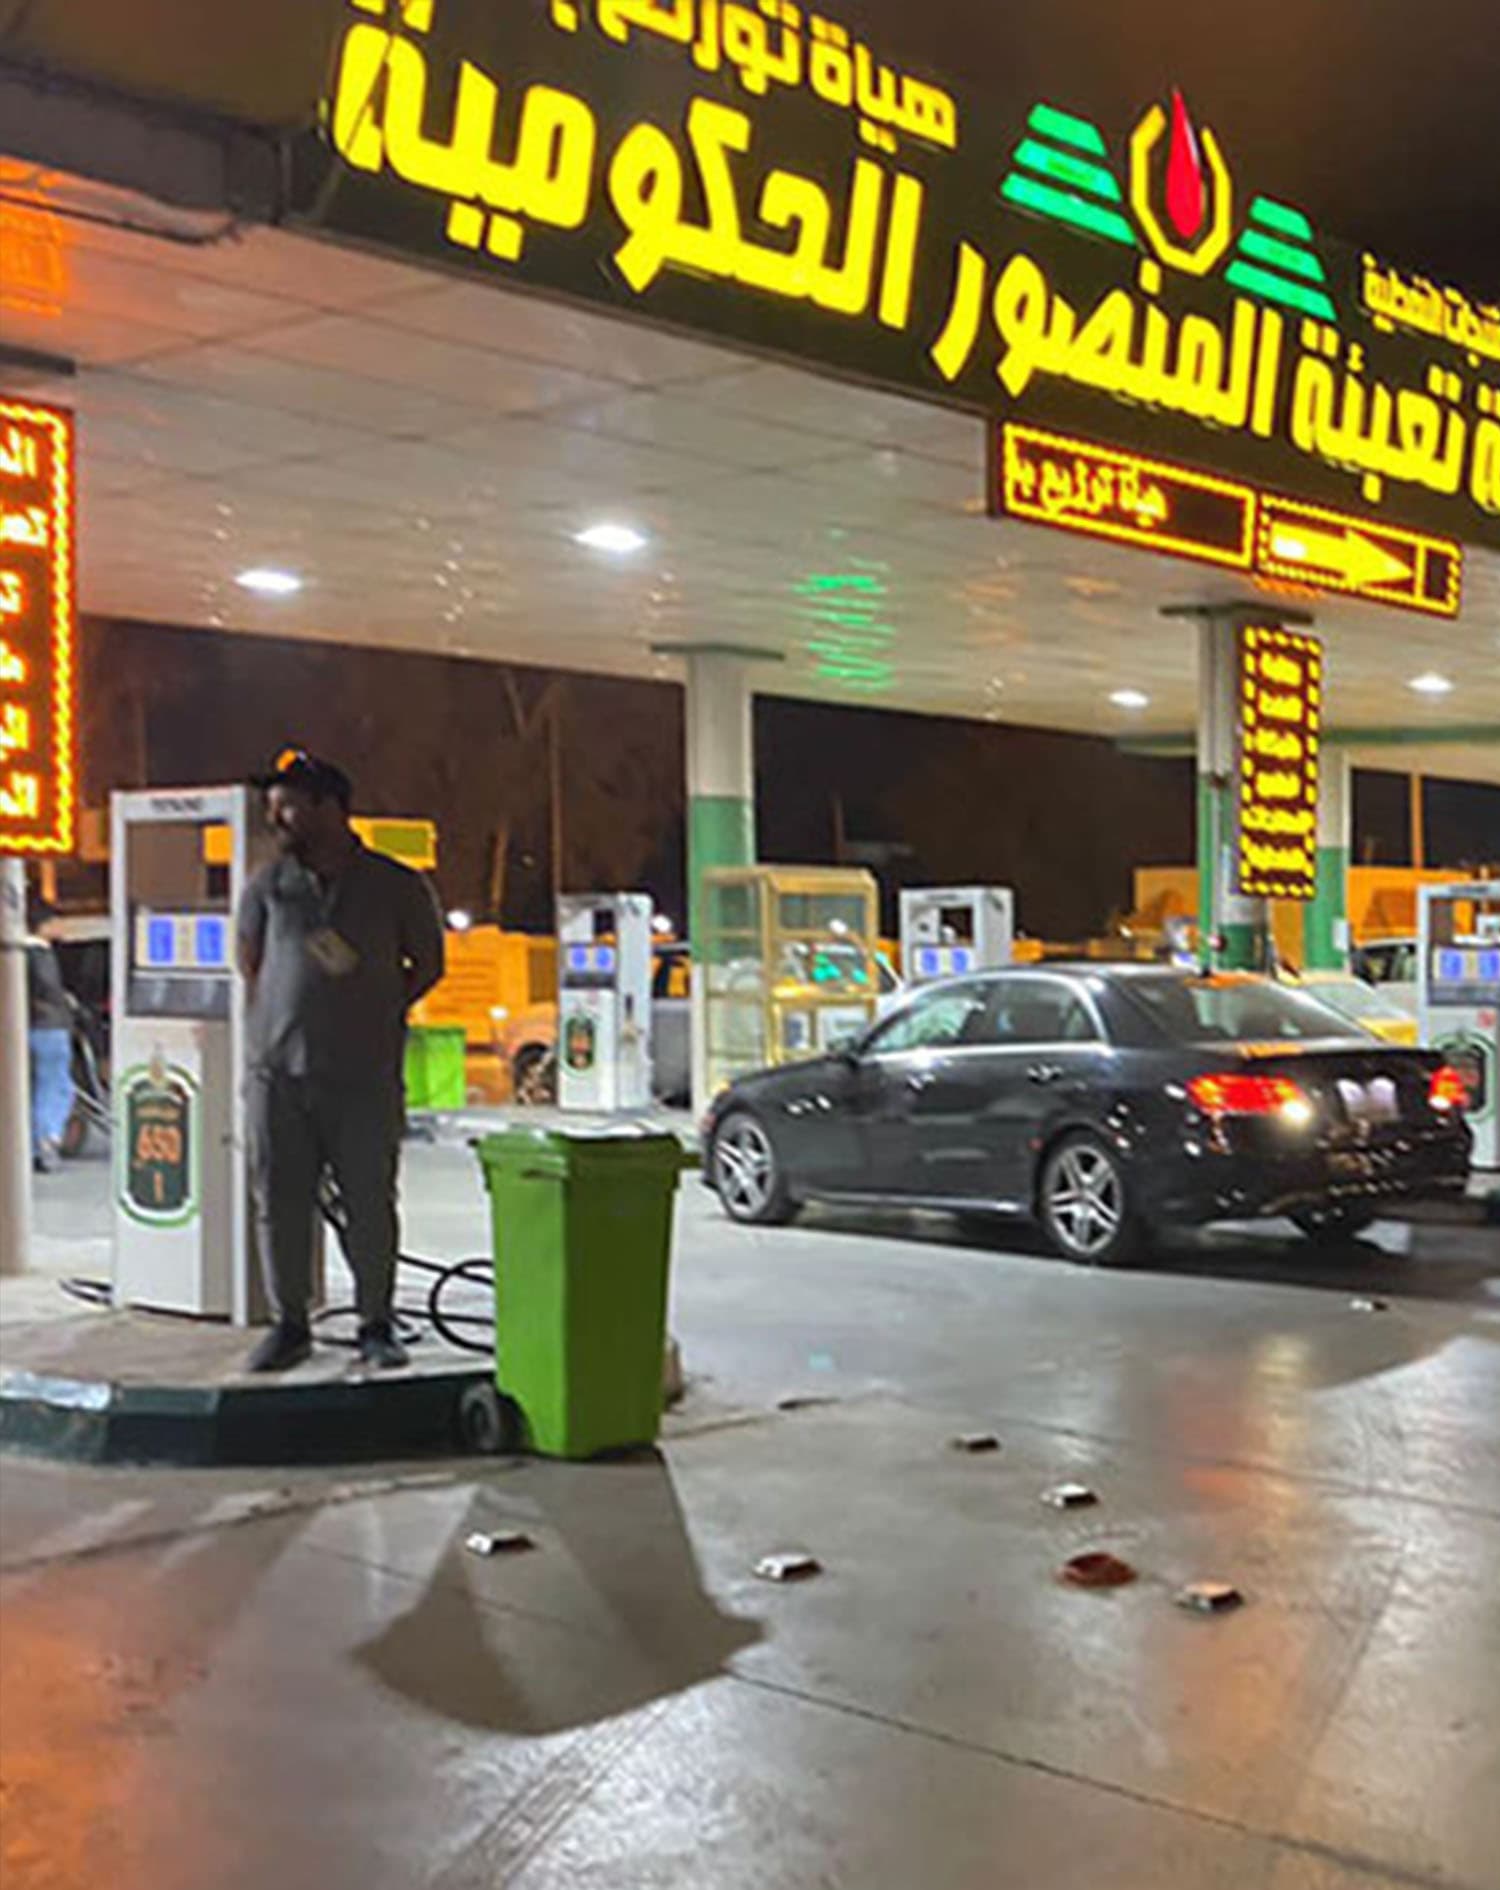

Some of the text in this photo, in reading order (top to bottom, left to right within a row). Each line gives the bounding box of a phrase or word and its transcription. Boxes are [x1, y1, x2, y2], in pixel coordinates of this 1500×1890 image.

[334, 0, 923, 331] الحكومية
[931, 241, 1283, 438] المنصور
[1291, 323, 1468, 502] تعبئة
